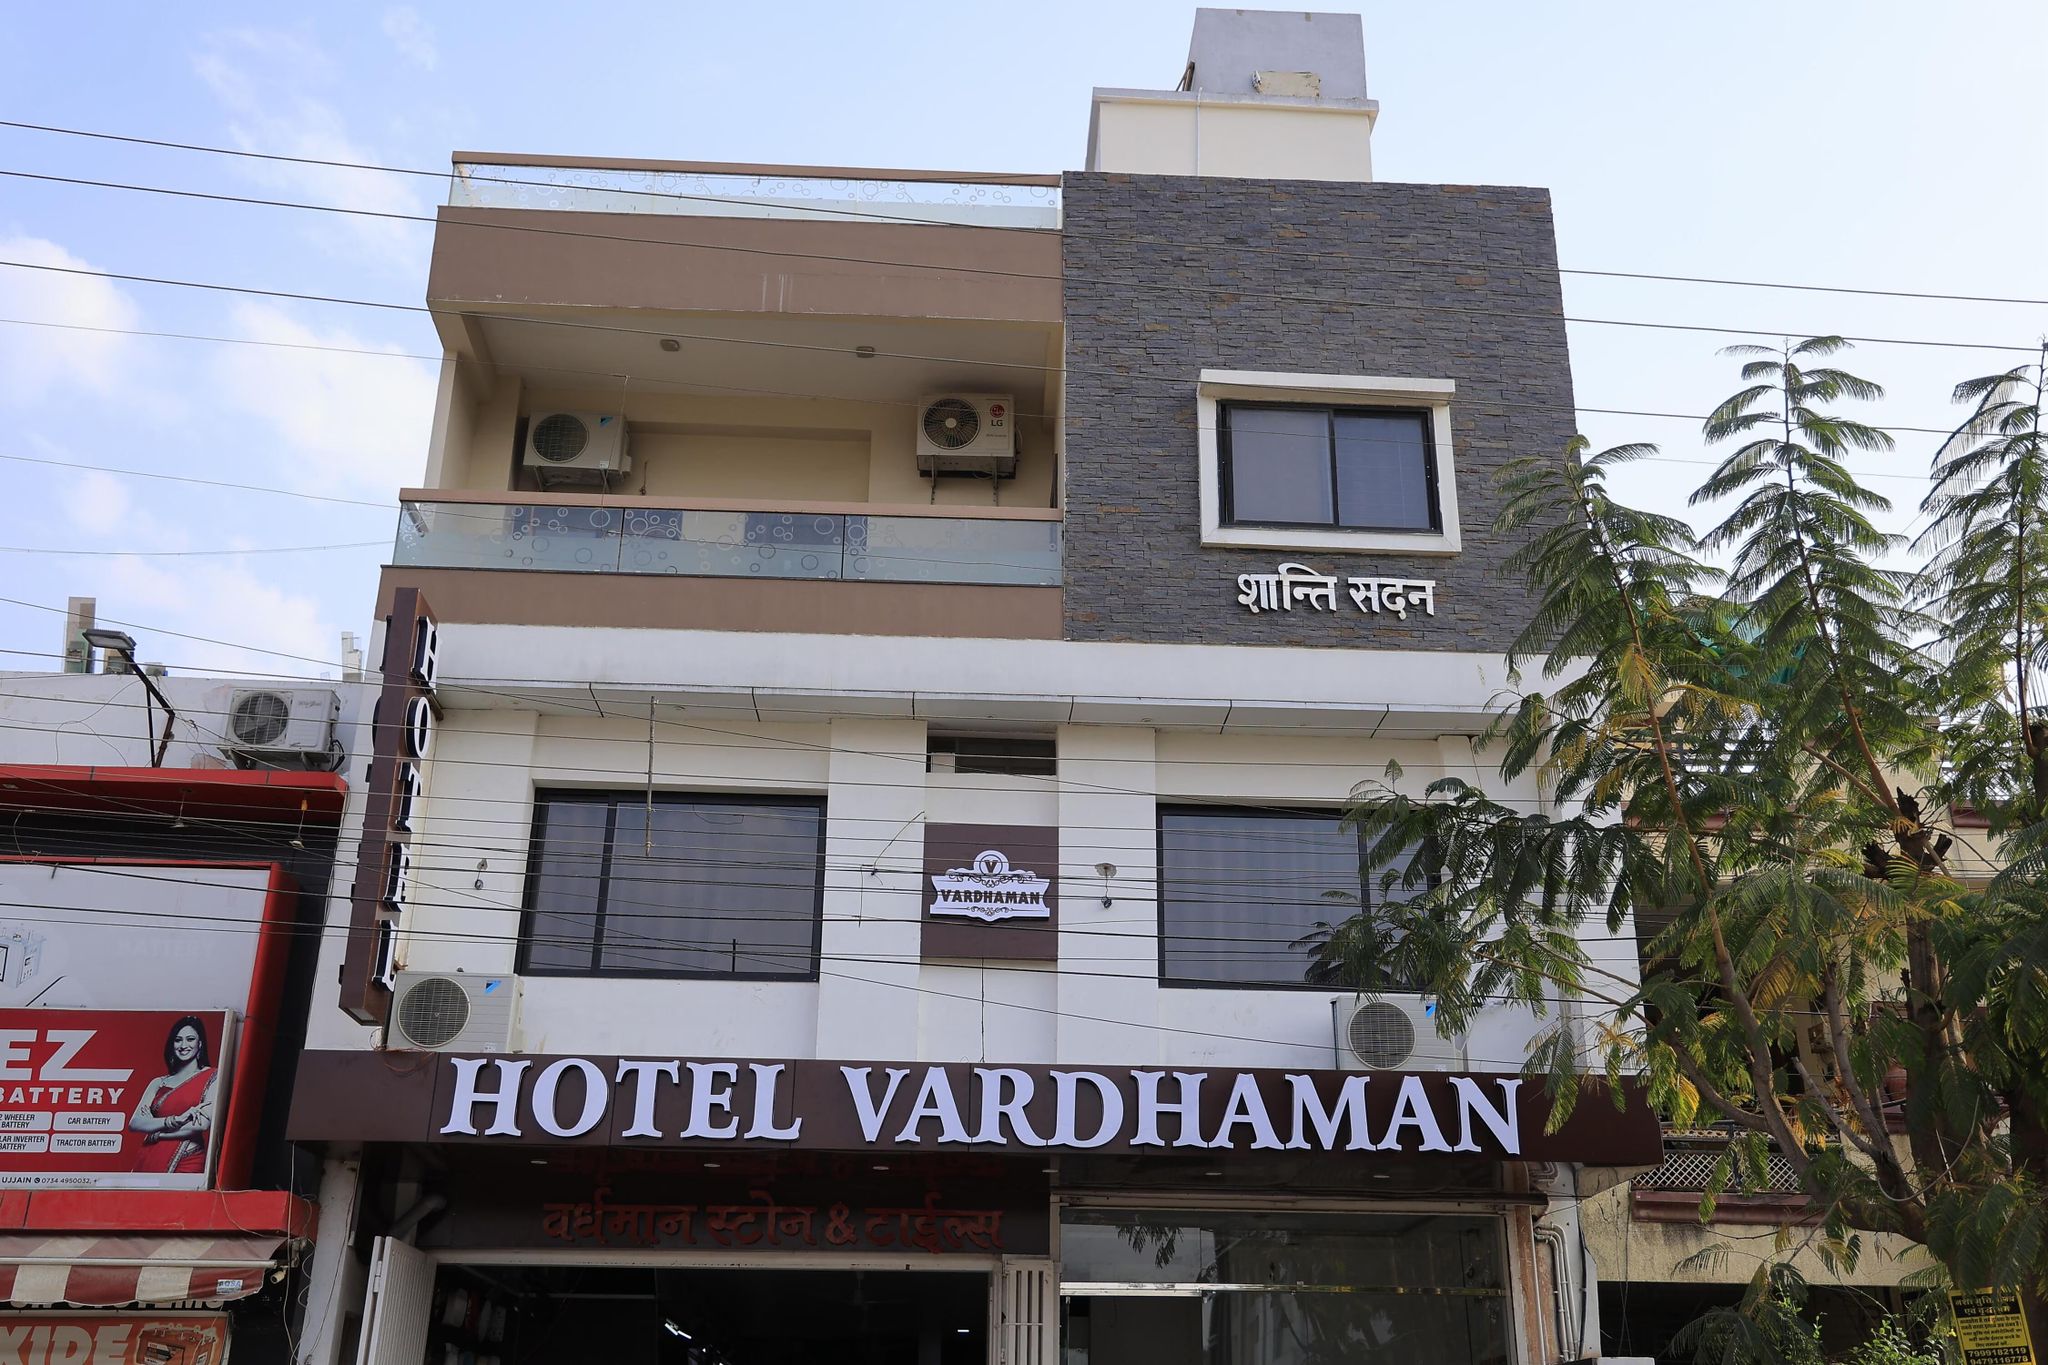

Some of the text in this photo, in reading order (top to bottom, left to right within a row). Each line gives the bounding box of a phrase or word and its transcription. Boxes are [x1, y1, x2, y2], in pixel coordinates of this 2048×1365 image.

[991, 419, 1003, 427] LG
[1237, 562, 1436, 620] शान्ति सदन
[984, 860, 998, 874] V
[940, 889, 1040, 905] VARDHAMAN
[440, 1057, 1524, 1156] HOTEL VARDHAMAN
[4, 1113, 35, 1121] WHEELER
[67, 1117, 82, 1125] CAR
[87, 1139, 116, 1147] BATTERY
[543, 1186, 699, 1244] वर्धमान
[705, 1188, 818, 1246] स्टोन
[825, 1202, 857, 1246] &
